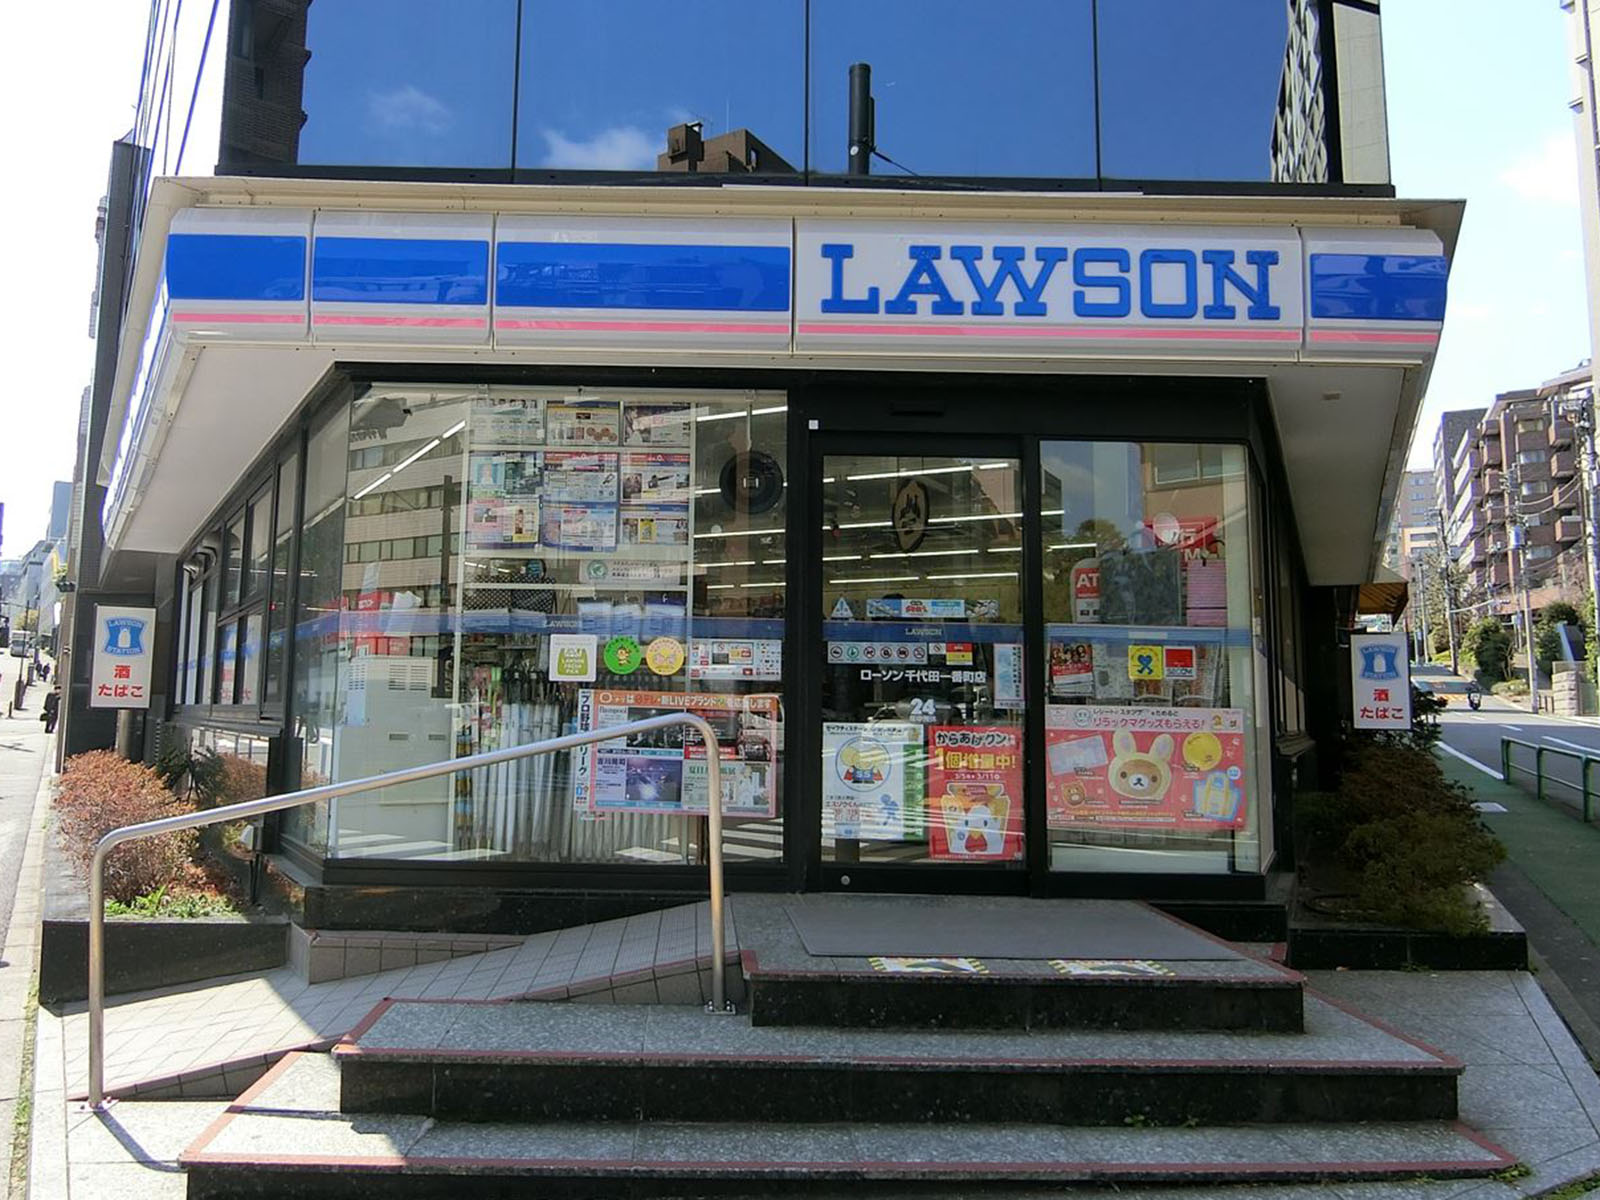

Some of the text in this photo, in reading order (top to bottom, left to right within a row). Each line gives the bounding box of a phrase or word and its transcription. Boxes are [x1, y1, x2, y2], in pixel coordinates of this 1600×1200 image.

[820, 243, 1281, 320] LAWSON
[1076, 573, 1100, 588] AT
[108, 619, 144, 629] LAWSON
[114, 665, 131, 679] 酒
[860, 669, 987, 683] ローソン千代田一番町店
[98, 684, 143, 698] たばこ
[1373, 689, 1389, 702] 酒
[910, 698, 936, 715] 24
[1360, 706, 1404, 719] たばこ
[936, 732, 1007, 747] からあげクン
